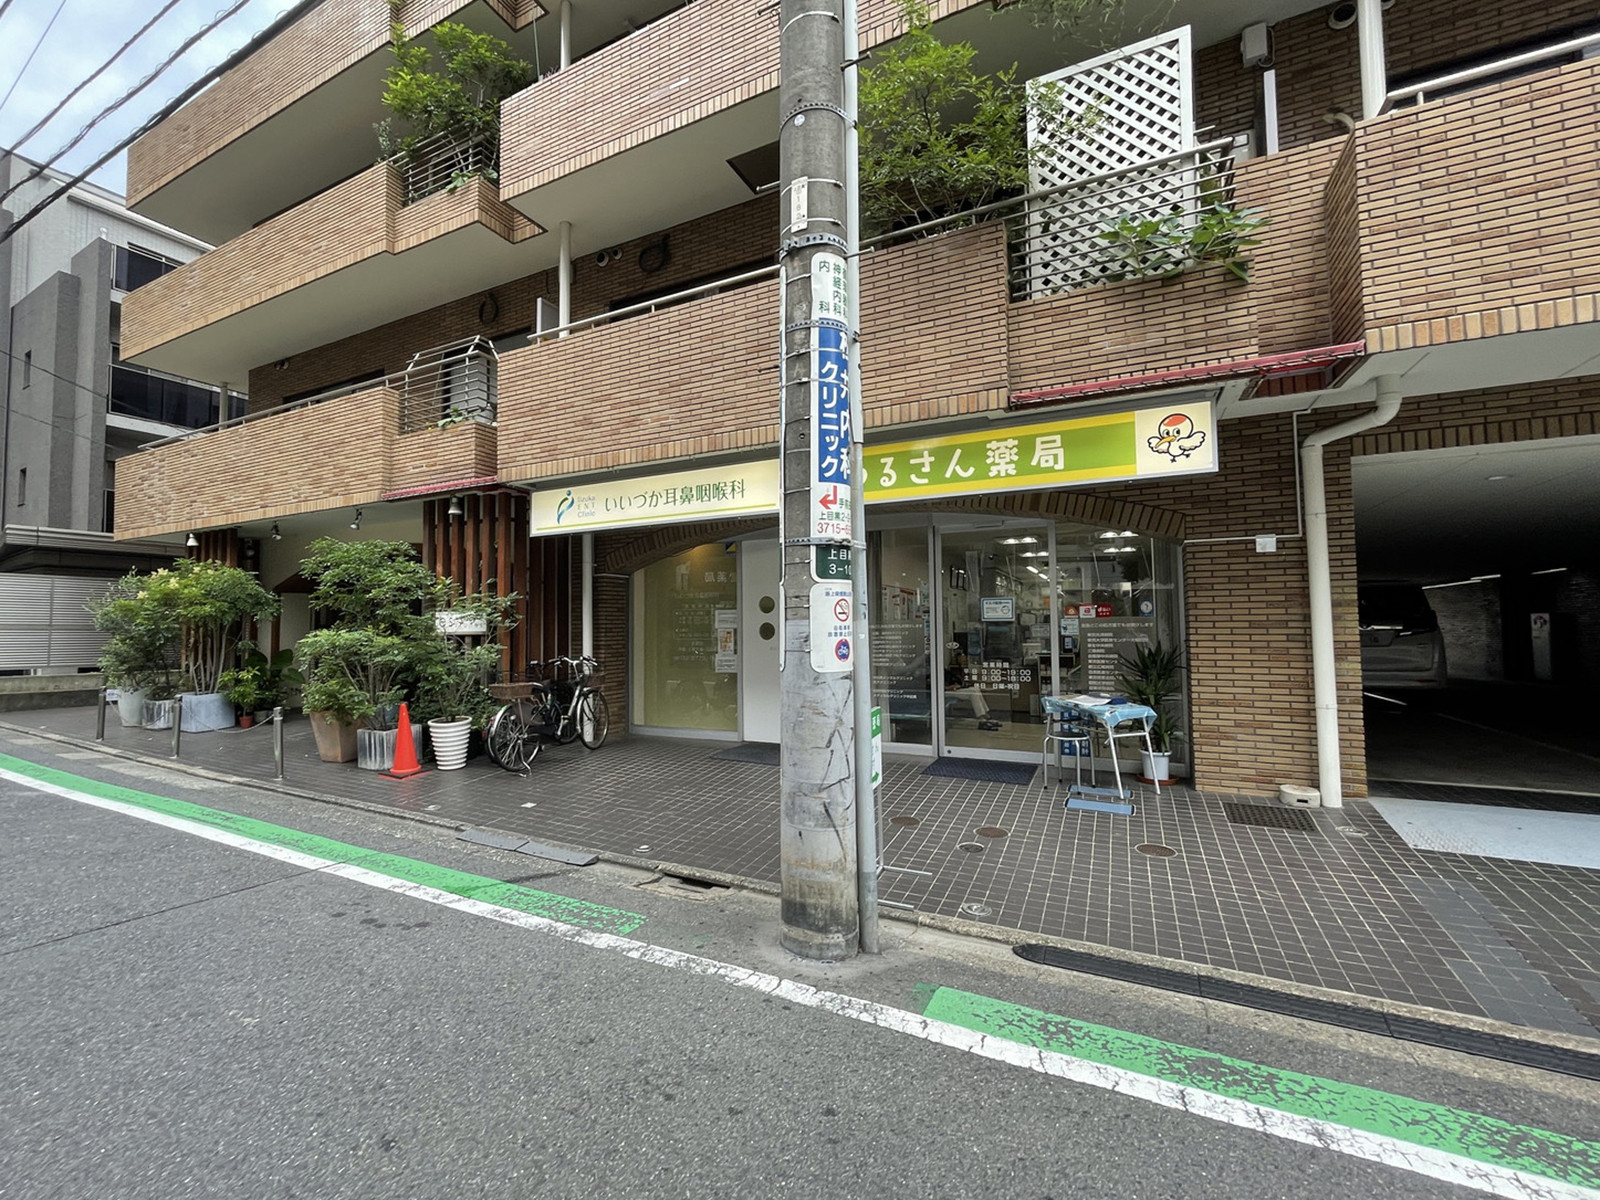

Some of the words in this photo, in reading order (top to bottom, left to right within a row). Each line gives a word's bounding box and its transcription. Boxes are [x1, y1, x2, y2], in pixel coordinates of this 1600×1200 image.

[818, 260, 830, 314] 内科
[820, 360, 839, 479] クリニック
[604, 478, 746, 512] いいづか耳鼻咽喉科
[828, 548, 851, 560] 上目
